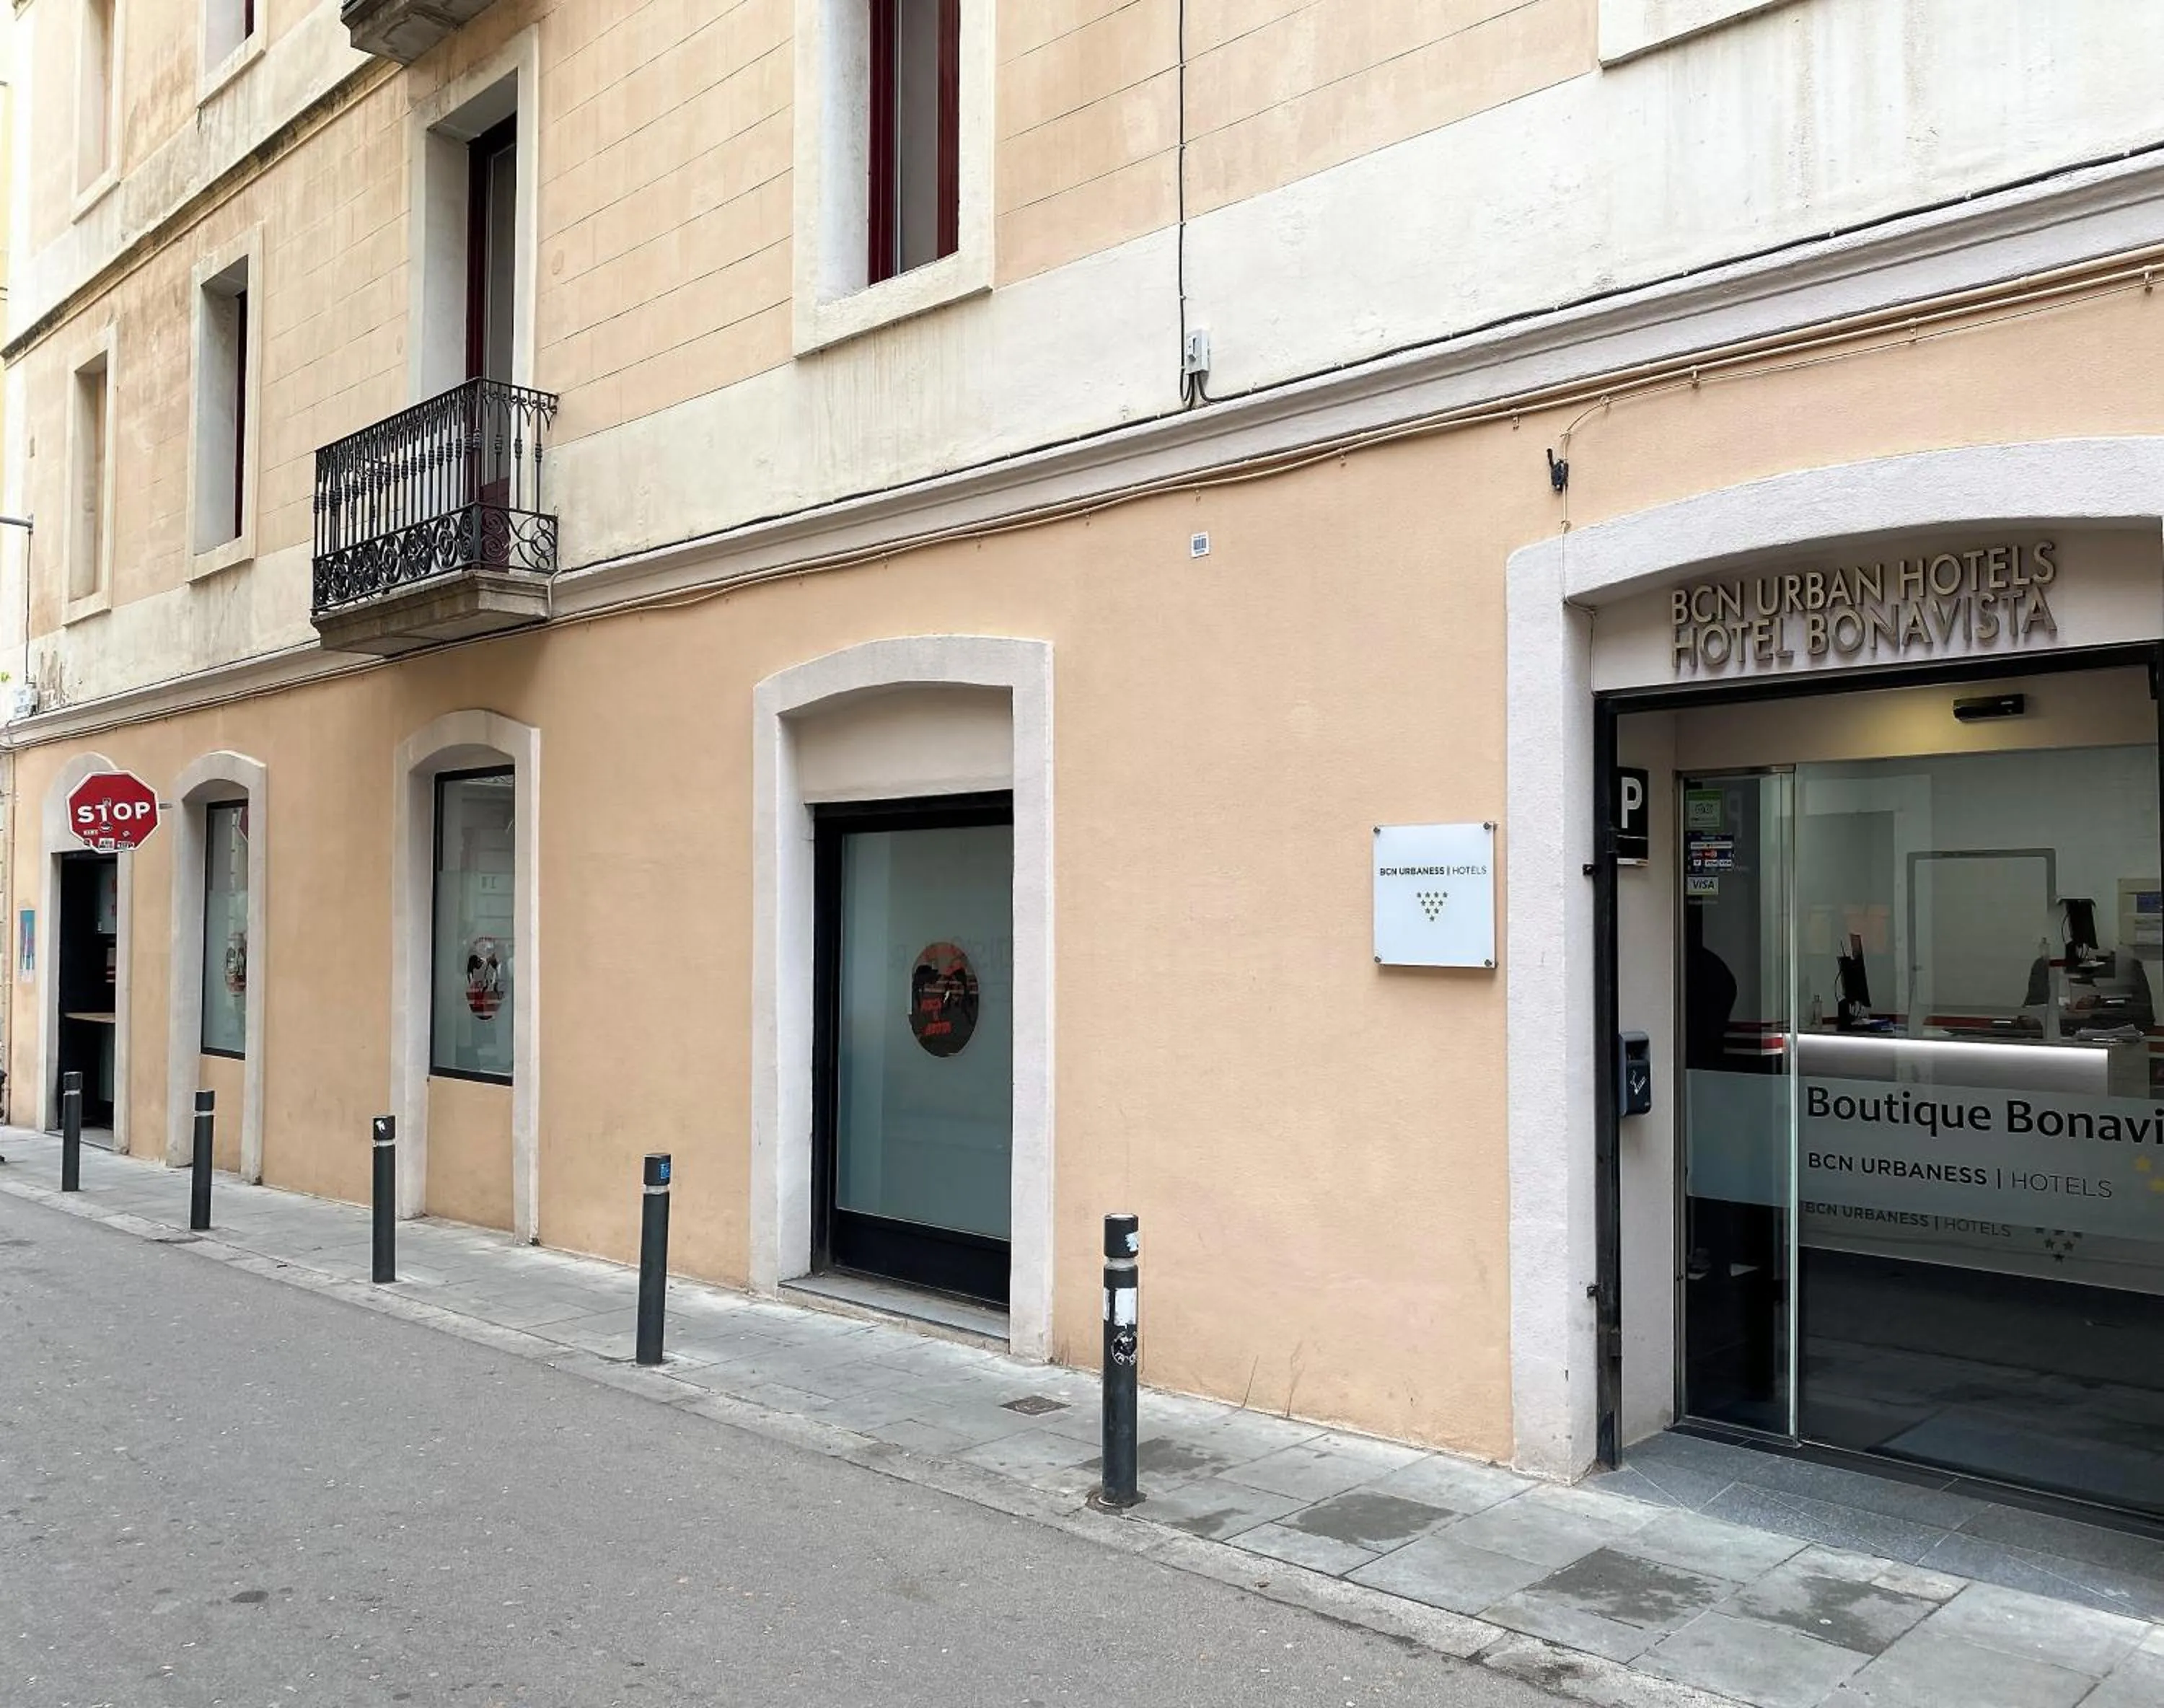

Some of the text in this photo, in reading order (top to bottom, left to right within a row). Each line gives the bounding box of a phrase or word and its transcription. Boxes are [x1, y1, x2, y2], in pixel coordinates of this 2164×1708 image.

[1672, 541, 2056, 625] BCN URBAN HOTELS
[1672, 586, 2057, 668] HOTEL BONAVISTA
[77, 801, 151, 823] STOP
[1621, 777, 1643, 829] P
[1399, 866, 1445, 876] URBANESS
[1452, 866, 1487, 875] HOTELS
[1692, 879, 1715, 889] VISA
[1807, 1086, 2164, 1145] Boutique Bonavi
[1808, 1153, 1853, 1172] BCN
[1861, 1157, 1987, 1185] URBANESS
[2012, 1171, 2113, 1199] HOTELS
[1805, 1202, 1837, 1216] BCN
[1842, 1205, 1929, 1228] URBANESS
[1945, 1218, 2011, 1238] HOTELS
